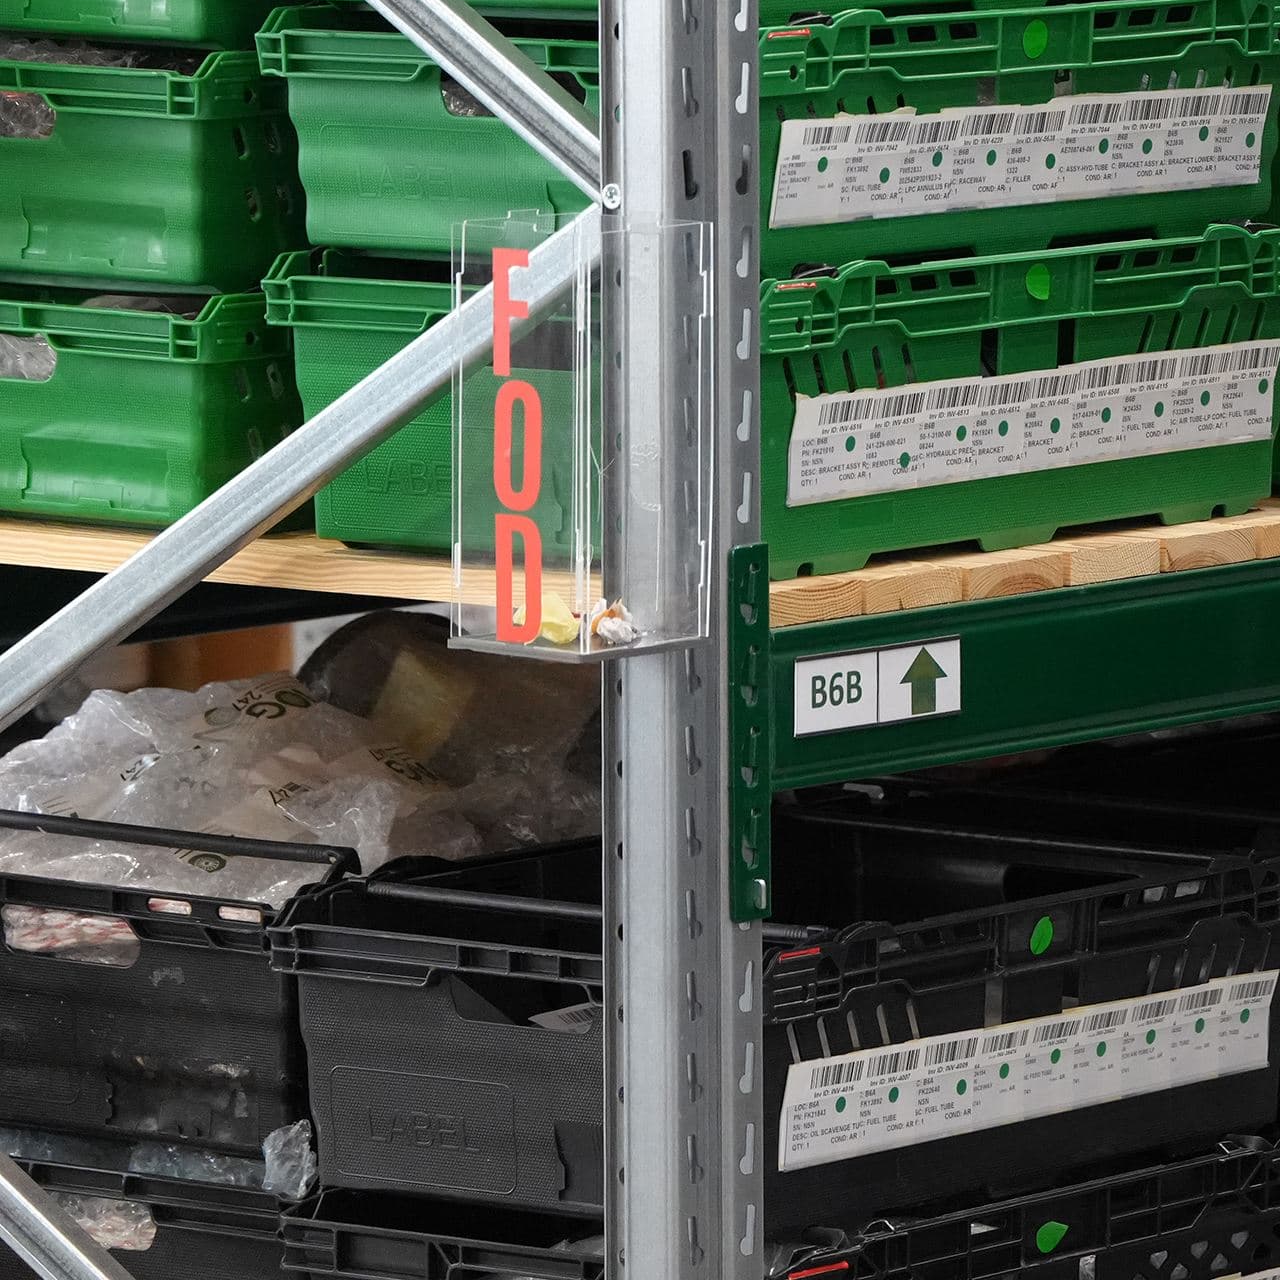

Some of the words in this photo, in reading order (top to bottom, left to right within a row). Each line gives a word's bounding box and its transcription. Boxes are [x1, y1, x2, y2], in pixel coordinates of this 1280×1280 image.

[1118, 161, 1143, 169] BRACKET
[1168, 157, 1193, 165] BRACKET
[358, 164, 469, 200] LABEL
[958, 177, 986, 185] RACEWAY
[1012, 175, 1031, 183] FILLER
[871, 193, 888, 201] COND:
[1229, 410, 1242, 418] FUEL
[1243, 408, 1257, 416] TUBE
[1127, 424, 1140, 432] FUEL
[1141, 421, 1155, 429] TUBE
[1078, 428, 1104, 437] BRACKET
[492, 248, 542, 644] FOD
[802, 439, 815, 447] LOC:
[1028, 438, 1054, 447] BRACKET
[802, 449, 811, 457] PN:
[926, 448, 959, 459] HYDRAULIC
[978, 446, 1004, 455] BRACKET
[872, 459, 895, 468] REMOTE
[801, 468, 818, 476] DESC:
[819, 464, 845, 474] BRACKET
[846, 462, 861, 470] ASSY
[801, 479, 813, 487] QTY:
[812, 670, 862, 709] B6B
[794, 1103, 807, 1112] LOC:
[924, 1105, 939, 1114] FUEL
[940, 1102, 955, 1110] TUBE
[866, 1117, 881, 1126] FUEL
[882, 1114, 897, 1123] TUBE
[367, 1106, 480, 1152] LABEL
[793, 1123, 802, 1131] SN:
[804, 1121, 815, 1129] NSN
[887, 1123, 905, 1132] COND:
[792, 1132, 809, 1141] DESC:
[810, 1130, 820, 1138] OIL
[821, 1125, 850, 1136] SCAVENGE
[792, 1143, 805, 1151] QTY:
